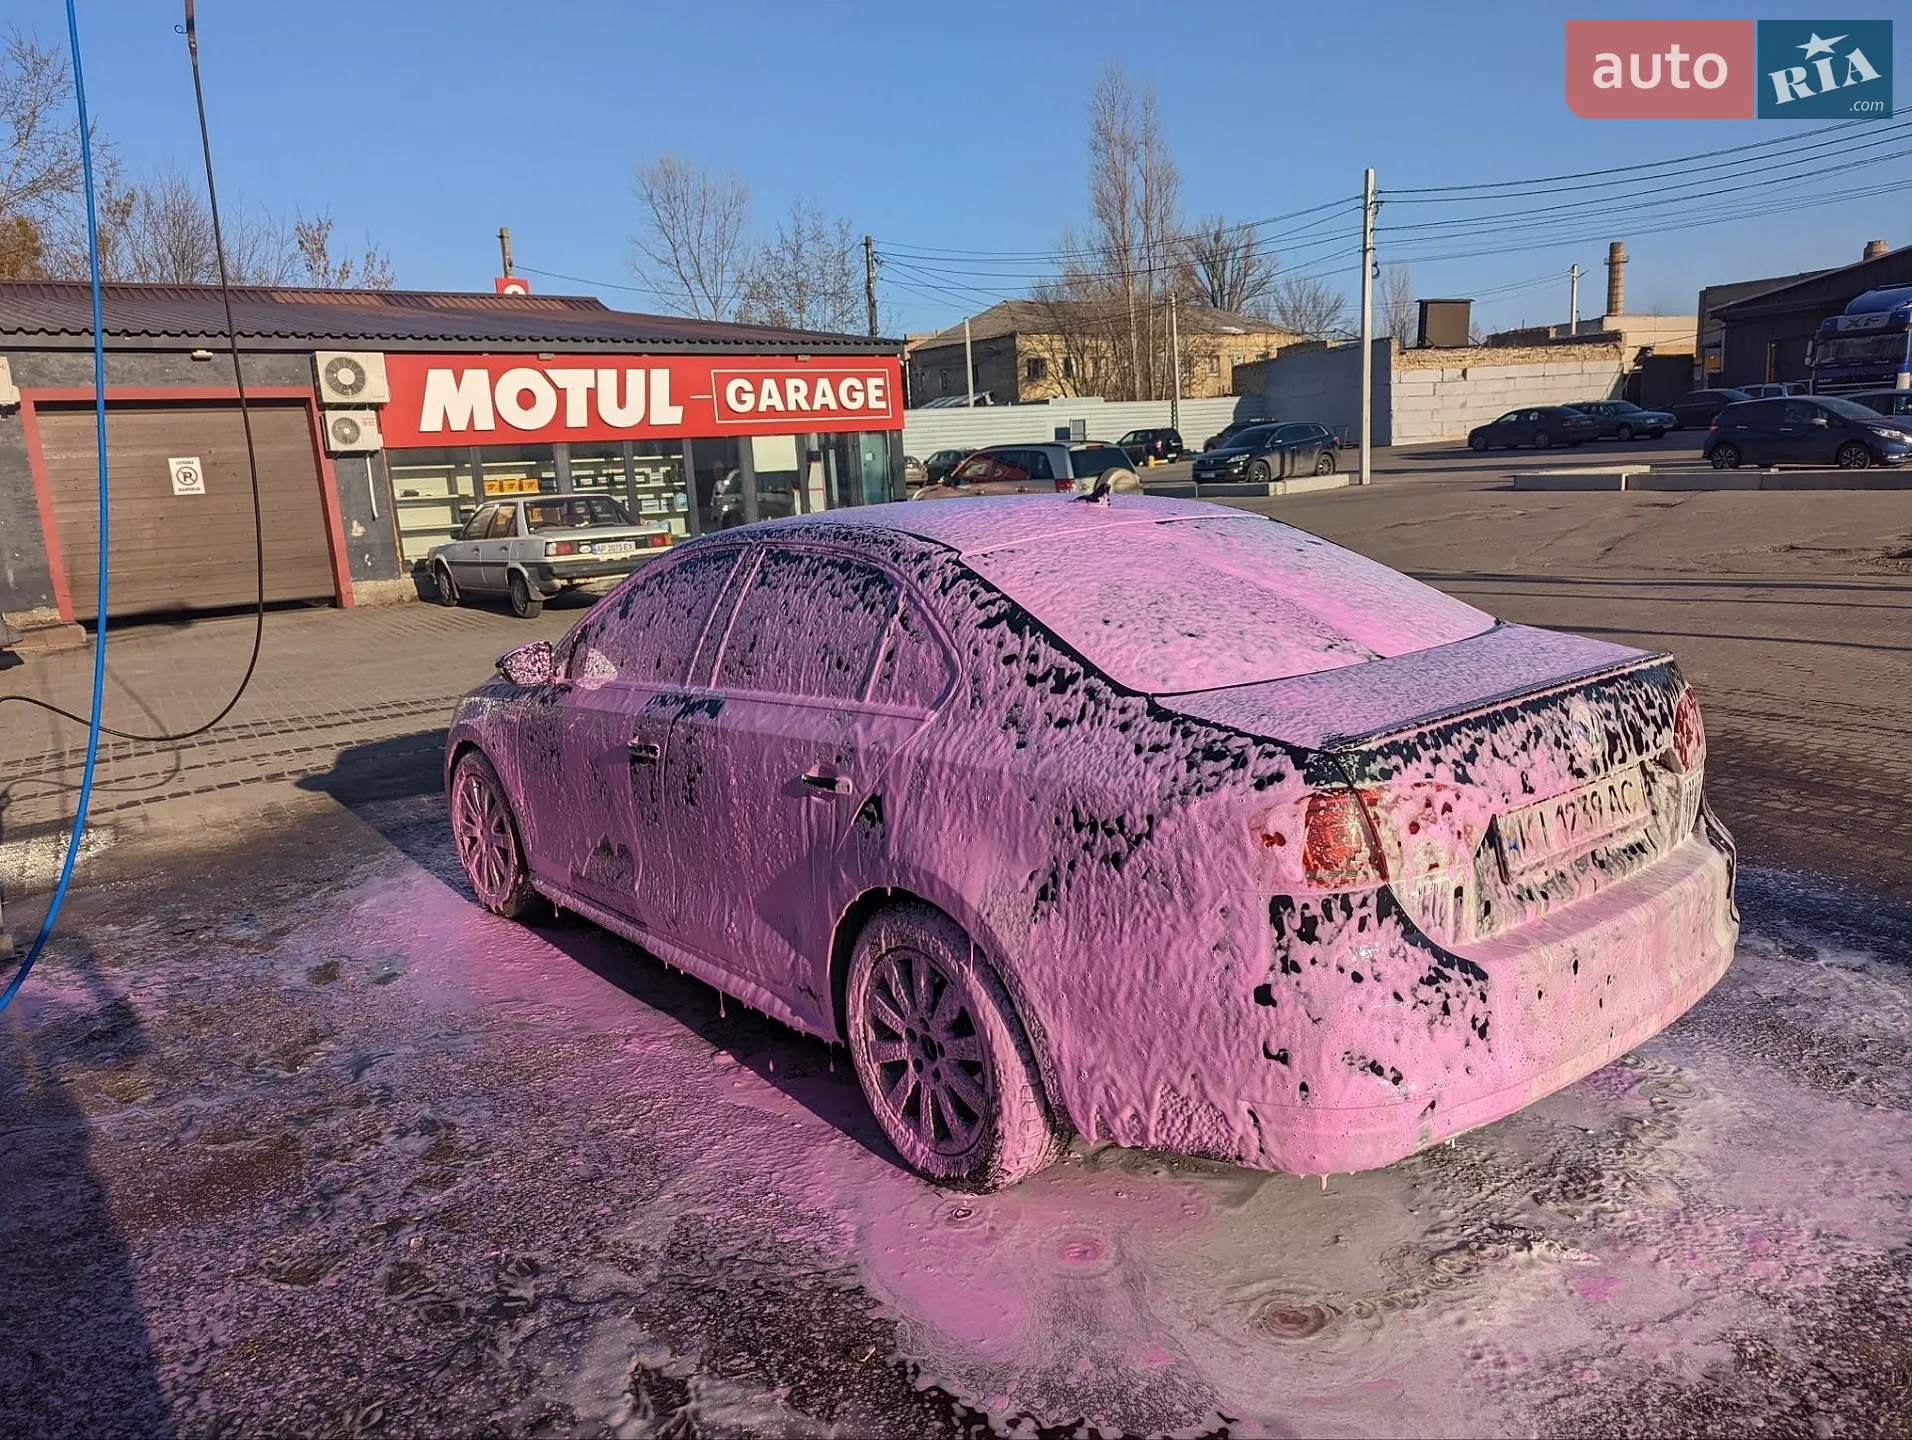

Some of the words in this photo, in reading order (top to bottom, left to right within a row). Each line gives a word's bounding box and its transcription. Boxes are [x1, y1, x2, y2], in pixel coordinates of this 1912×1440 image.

[1844, 315, 1883, 329] XF
[418, 367, 684, 432] MOTUL
[725, 377, 888, 413] GARAGE
